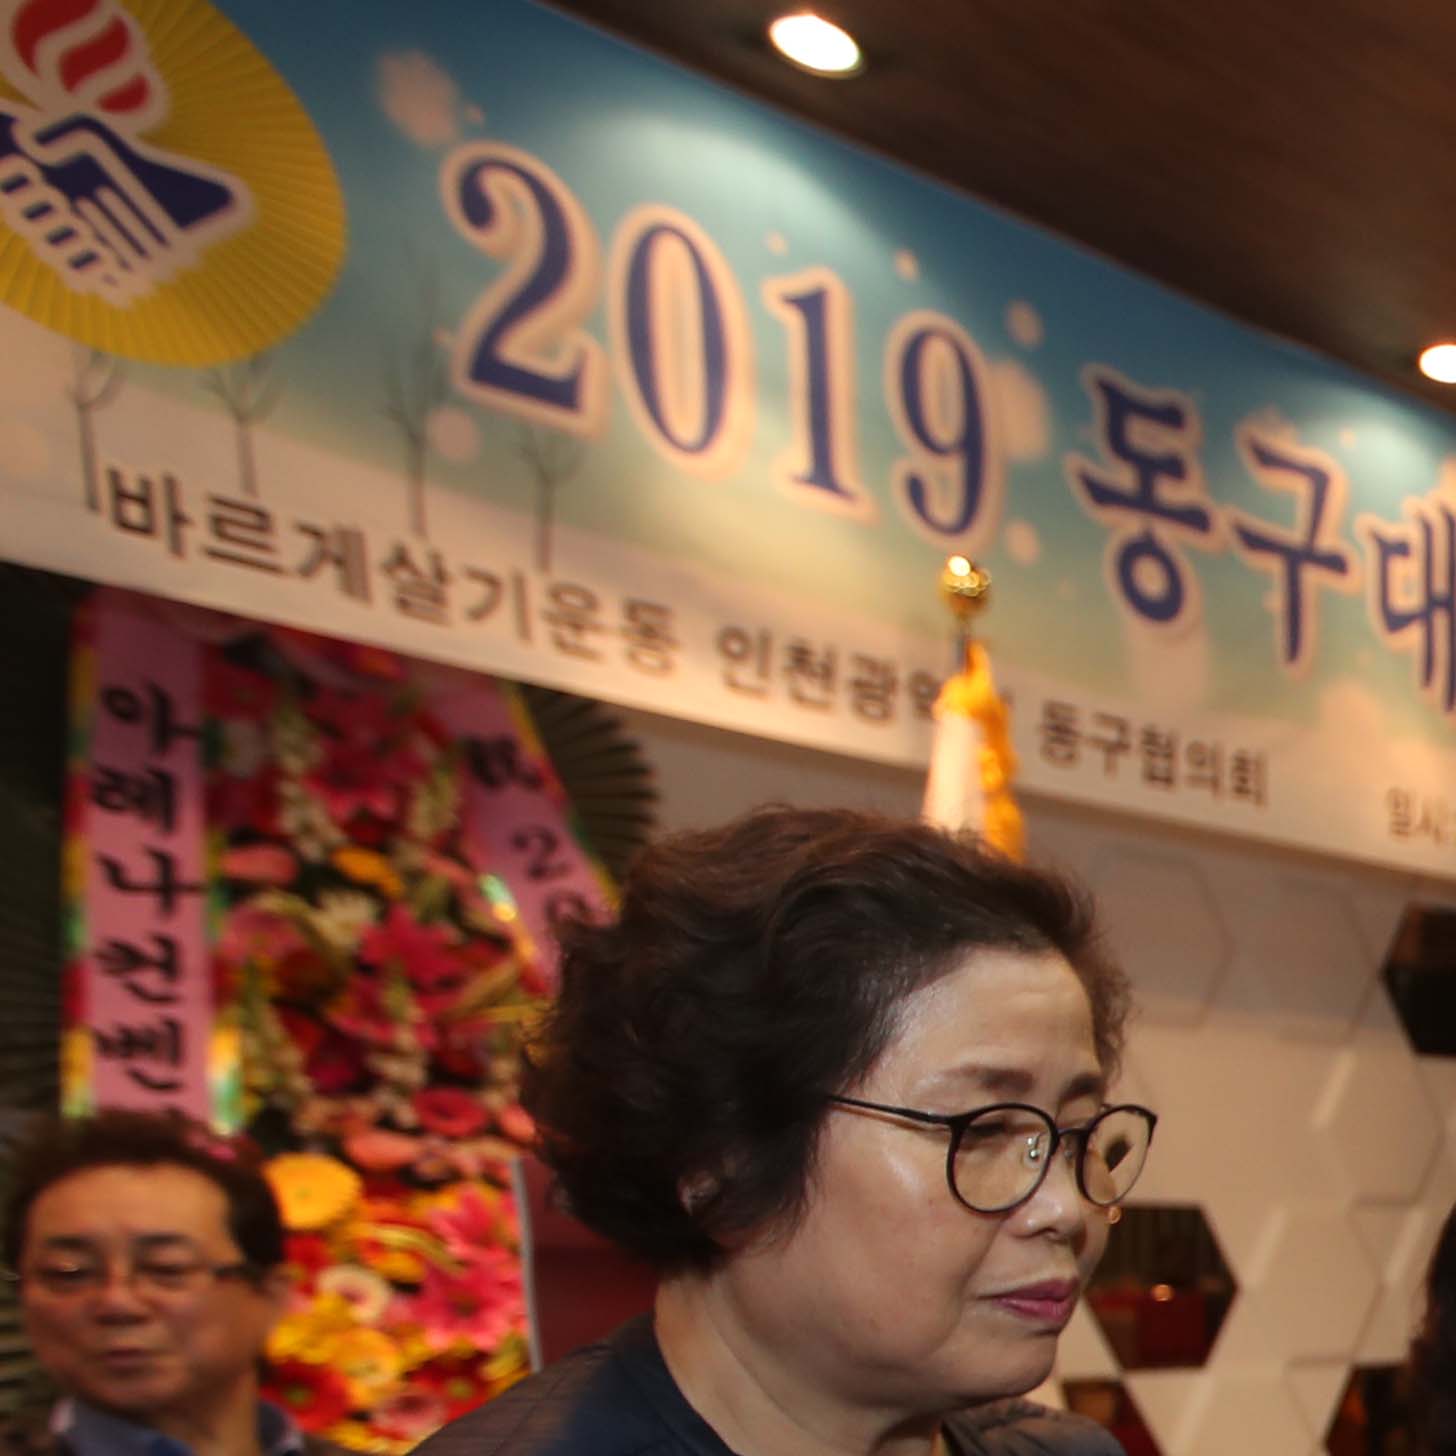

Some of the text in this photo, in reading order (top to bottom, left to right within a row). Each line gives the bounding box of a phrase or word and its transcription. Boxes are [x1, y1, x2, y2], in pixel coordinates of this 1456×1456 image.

[446, 147, 998, 545] 2019
[104, 462, 1271, 808] 바르게살기운동 인천광역 동구협의회
[94, 681, 206, 1104] 아레나컨벤
